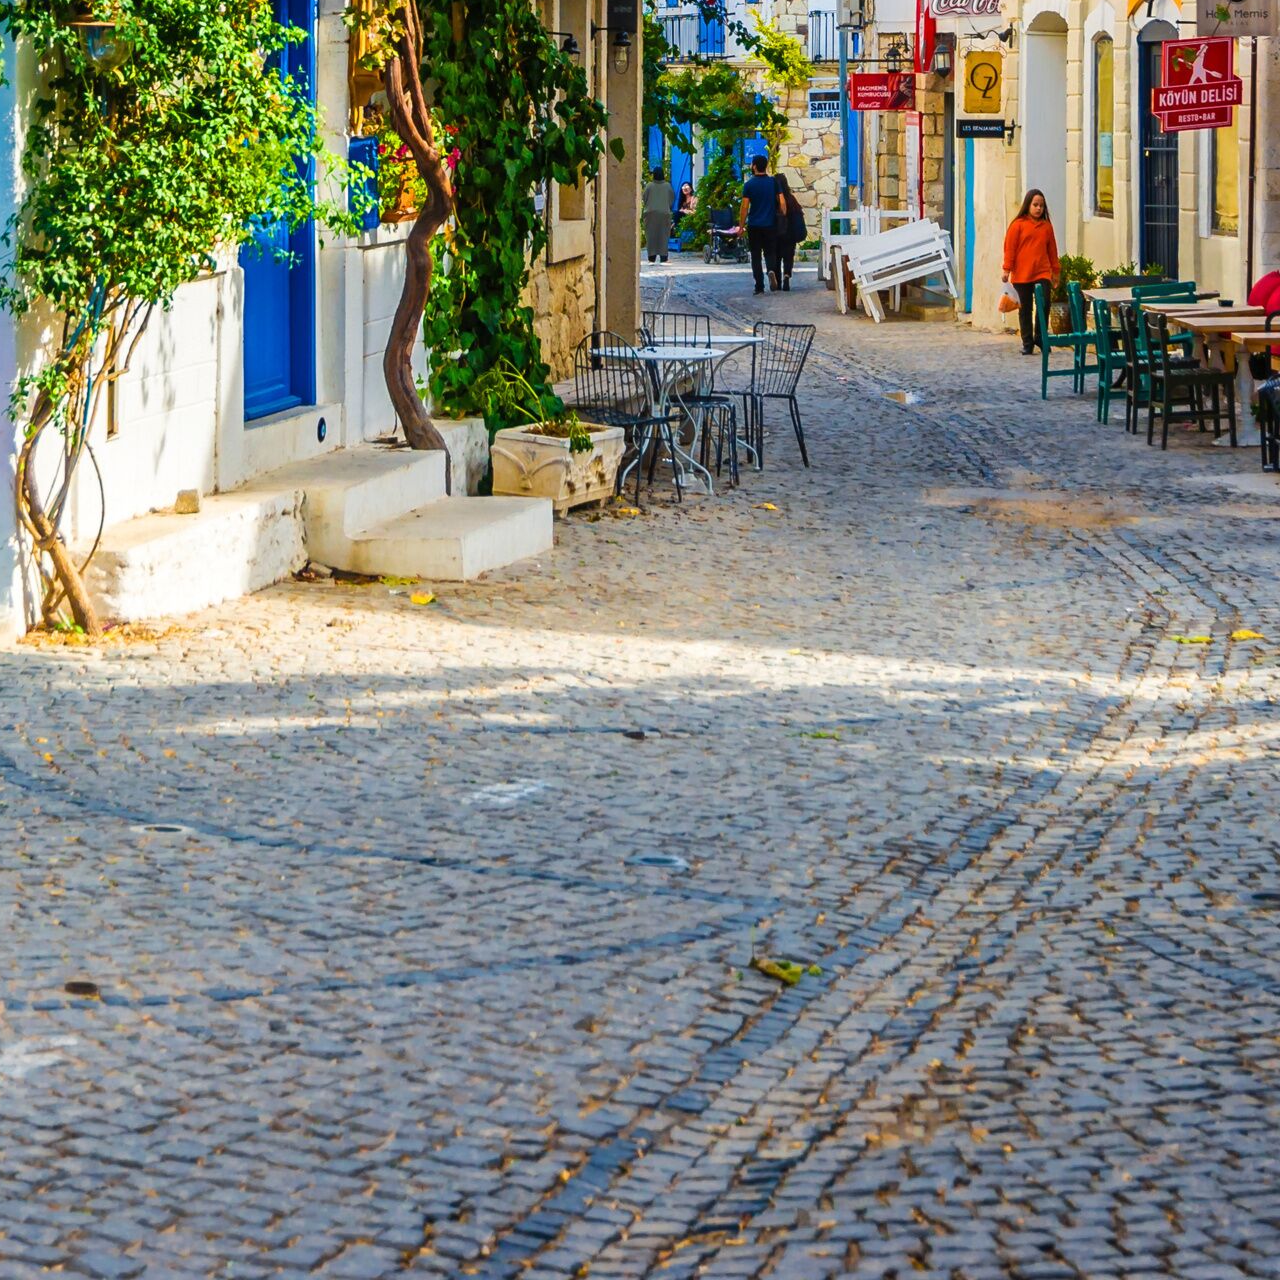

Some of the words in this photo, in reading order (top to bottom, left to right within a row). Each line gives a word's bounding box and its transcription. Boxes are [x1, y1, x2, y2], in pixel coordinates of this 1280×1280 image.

[1234, 9, 1269, 19] Memiş
[1159, 89, 1197, 107] KÖYÜN
[1201, 83, 1238, 104] DELİSİ
[810, 102, 840, 111] SATILI
